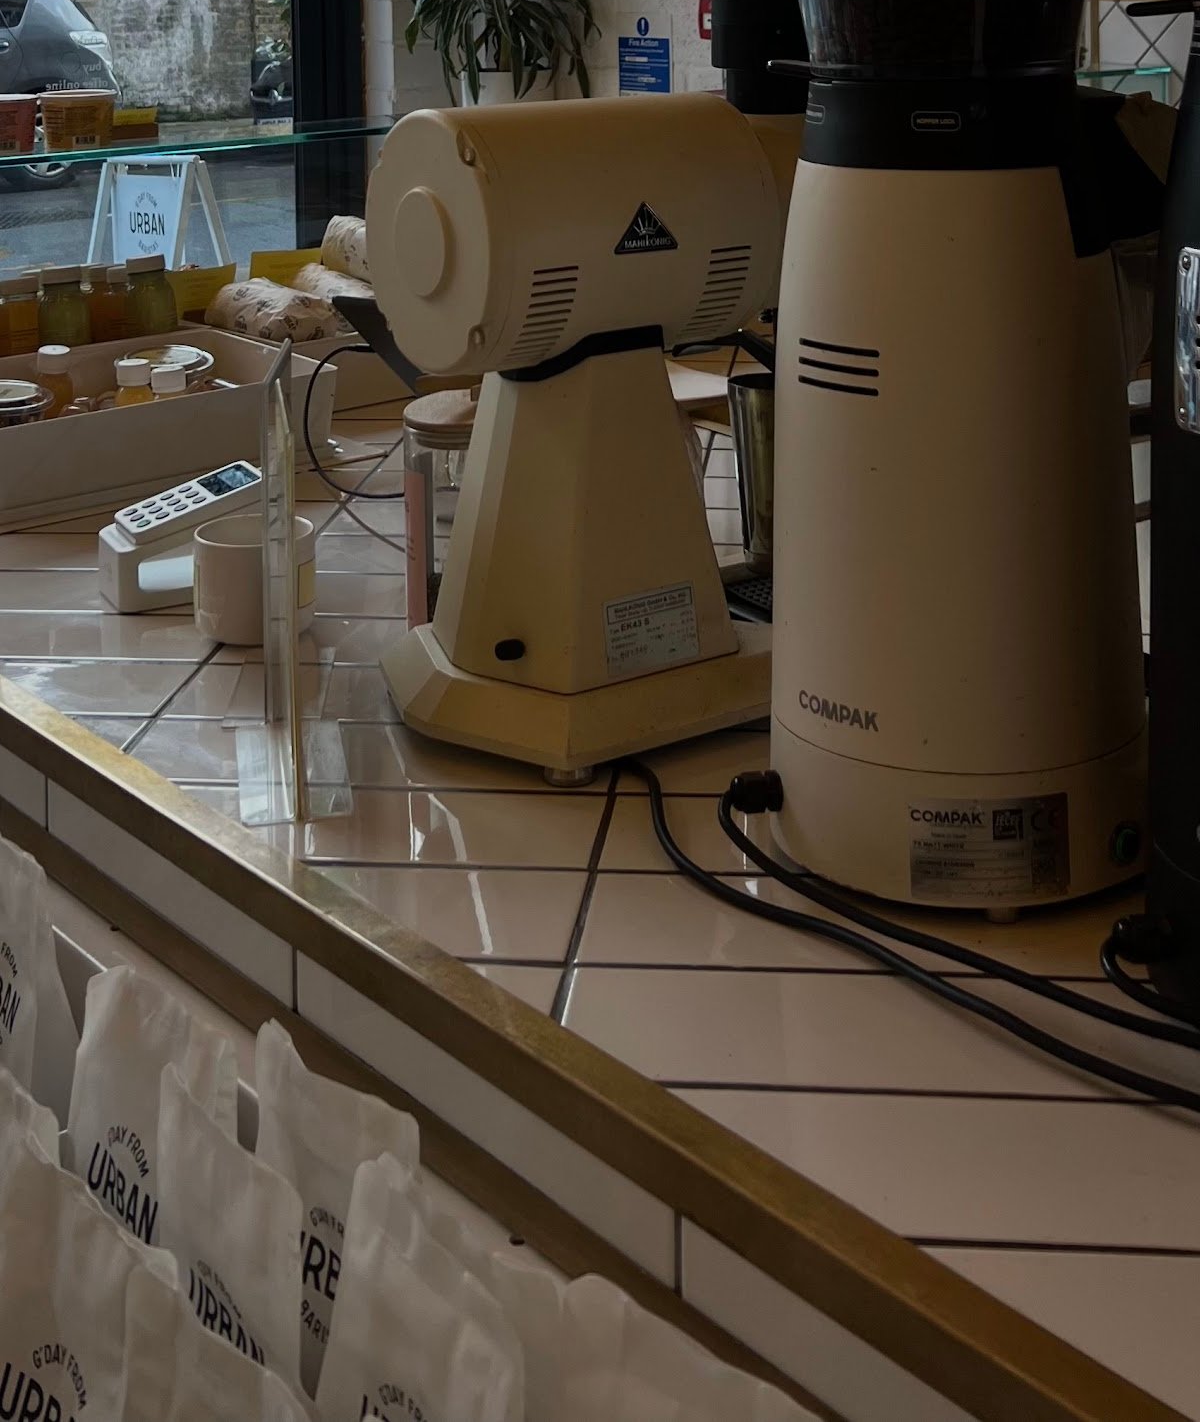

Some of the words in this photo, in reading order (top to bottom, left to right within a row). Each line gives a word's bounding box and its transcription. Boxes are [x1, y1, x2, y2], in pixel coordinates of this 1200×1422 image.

[129, 211, 165, 236] URBAN
[799, 689, 879, 732] COMPAK
[910, 809, 984, 825] COMPAK
[127, 1131, 149, 1178] FROM
[87, 1141, 159, 1246] URBAN
[33, 1343, 68, 1370] G'DAY
